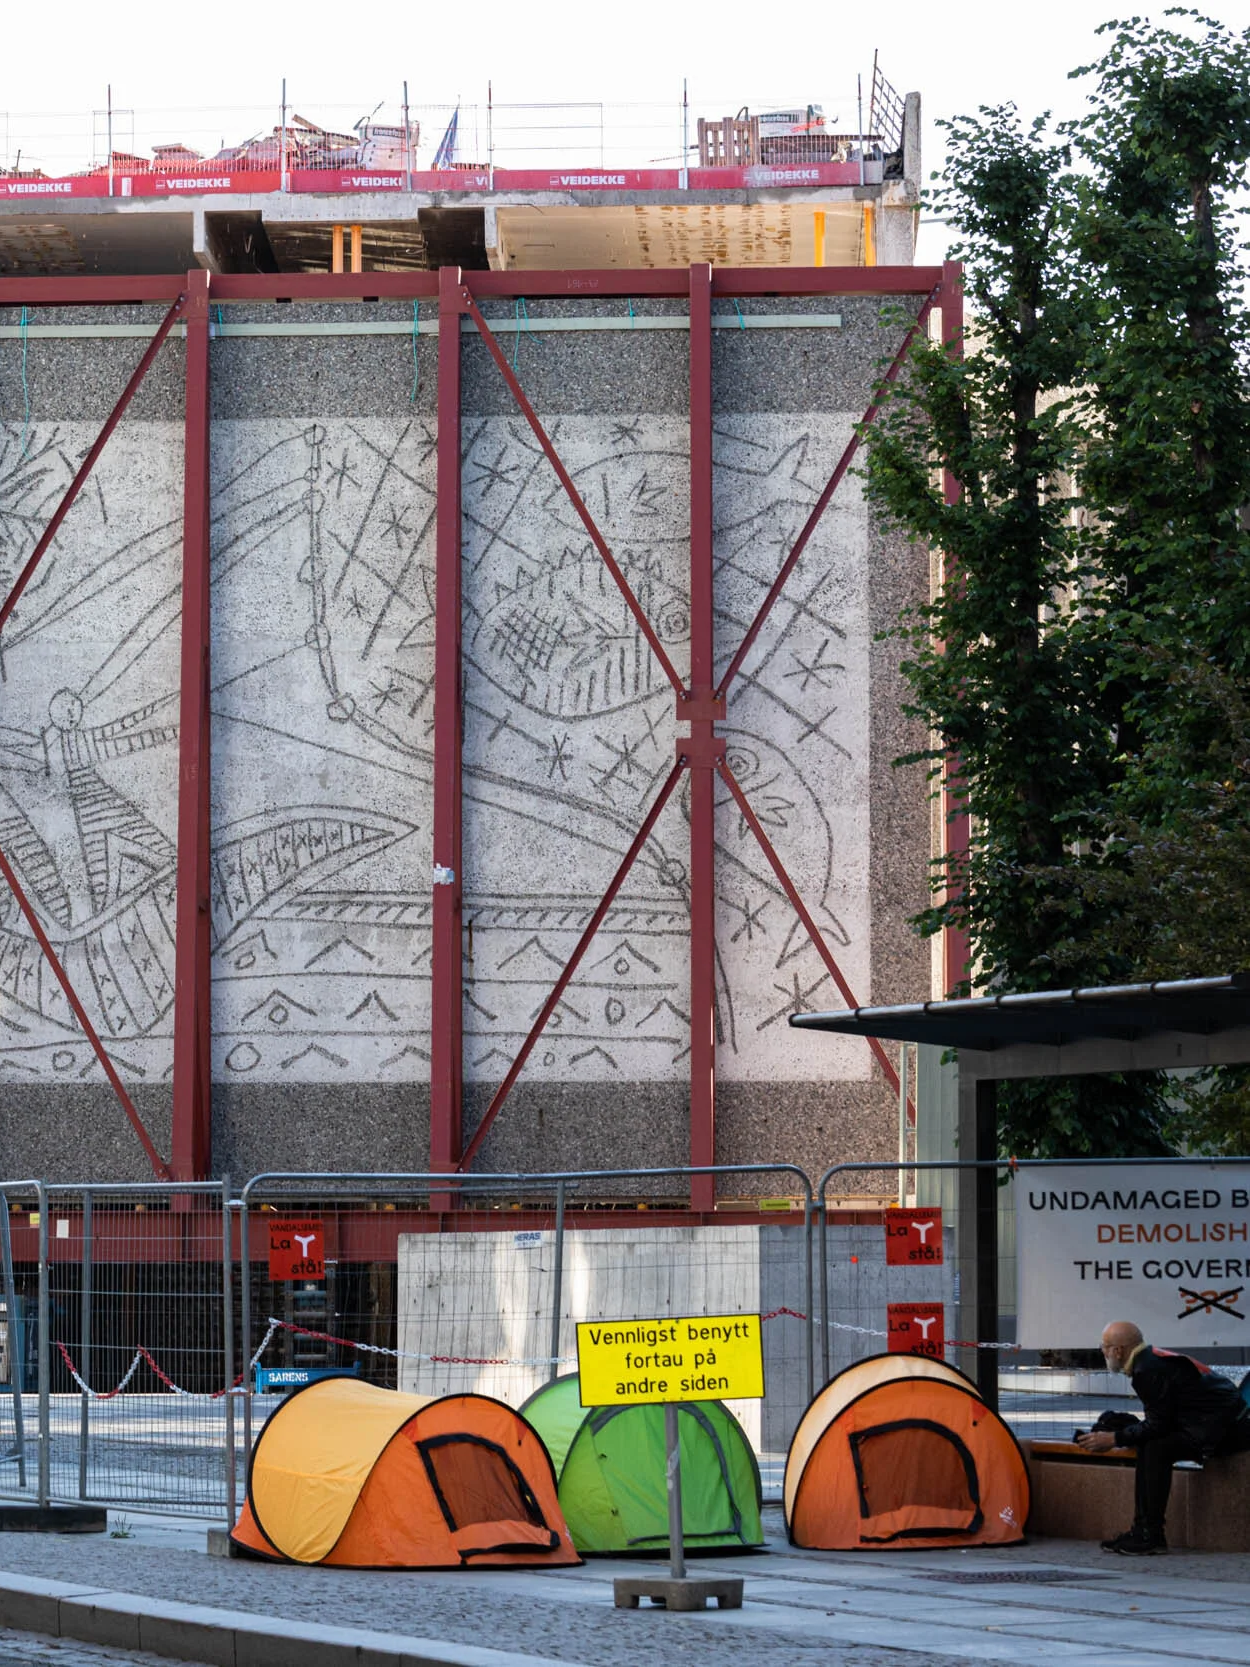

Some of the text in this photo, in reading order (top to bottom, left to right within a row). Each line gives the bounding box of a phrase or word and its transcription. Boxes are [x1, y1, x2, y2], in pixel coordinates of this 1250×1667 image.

[560, 174, 626, 186] VEIDEKKE
[754, 169, 819, 181] VEIDEKKE
[7, 182, 72, 194] VEIDEKKE
[166, 177, 231, 189] VEIDEKKE
[1029, 1189, 1221, 1211] UNDAMAGED
[887, 1224, 908, 1237] La
[1097, 1223, 1248, 1243] DEMOLISH
[270, 1237, 291, 1250] La
[908, 1244, 941, 1260] stå!
[291, 1258, 322, 1275] stå!
[1074, 1260, 1133, 1280] THE
[889, 1319, 910, 1332] La
[589, 1322, 749, 1347] Vennligst benytt
[910, 1340, 942, 1355] stå!
[625, 1347, 717, 1370] fortau på
[268, 1372, 309, 1382] SARENS
[615, 1374, 729, 1395] andre siden
